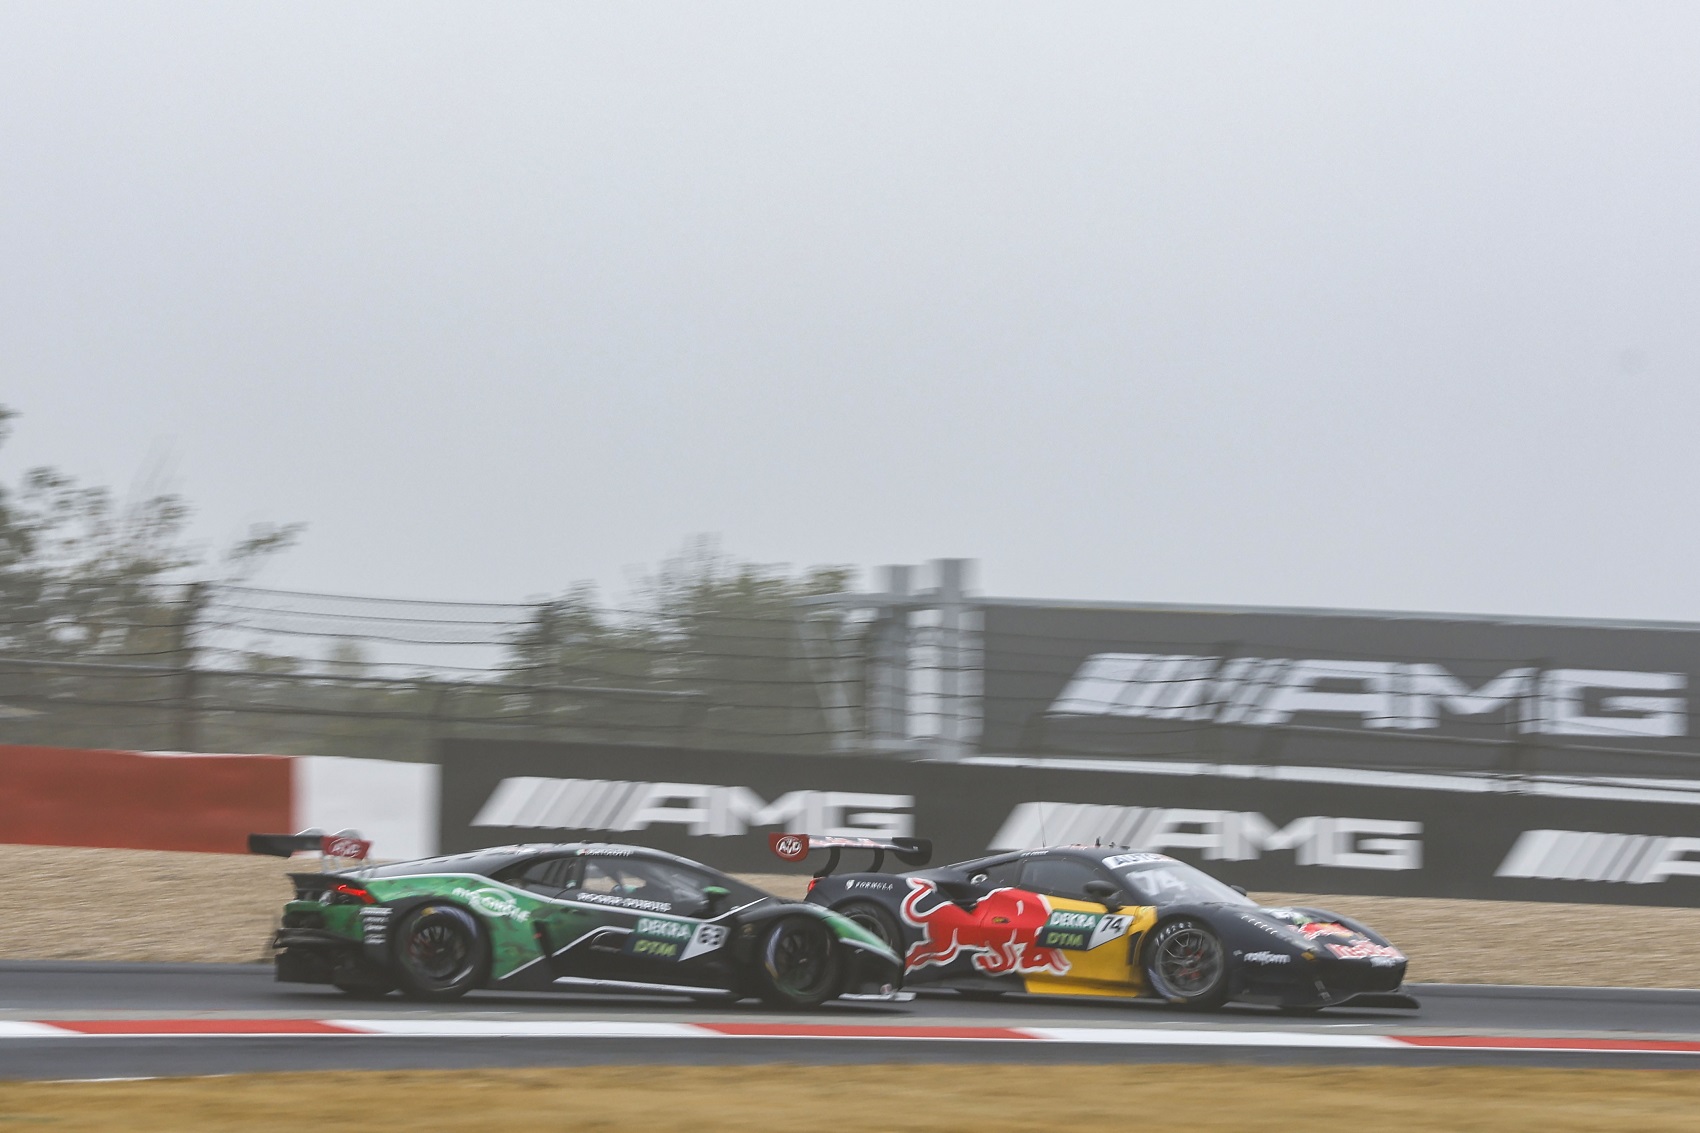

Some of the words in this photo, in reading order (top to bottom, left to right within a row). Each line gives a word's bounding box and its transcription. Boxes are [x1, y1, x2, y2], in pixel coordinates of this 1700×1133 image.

[1246, 658, 1687, 738] AMG
[615, 781, 915, 838] AMG
[1130, 806, 1423, 870] AMG
[637, 917, 692, 940] DEKRA
[1050, 910, 1097, 929] DEKRA
[1101, 915, 1124, 934] 74
[632, 939, 678, 957] DTM
[1045, 931, 1084, 946] DTM
